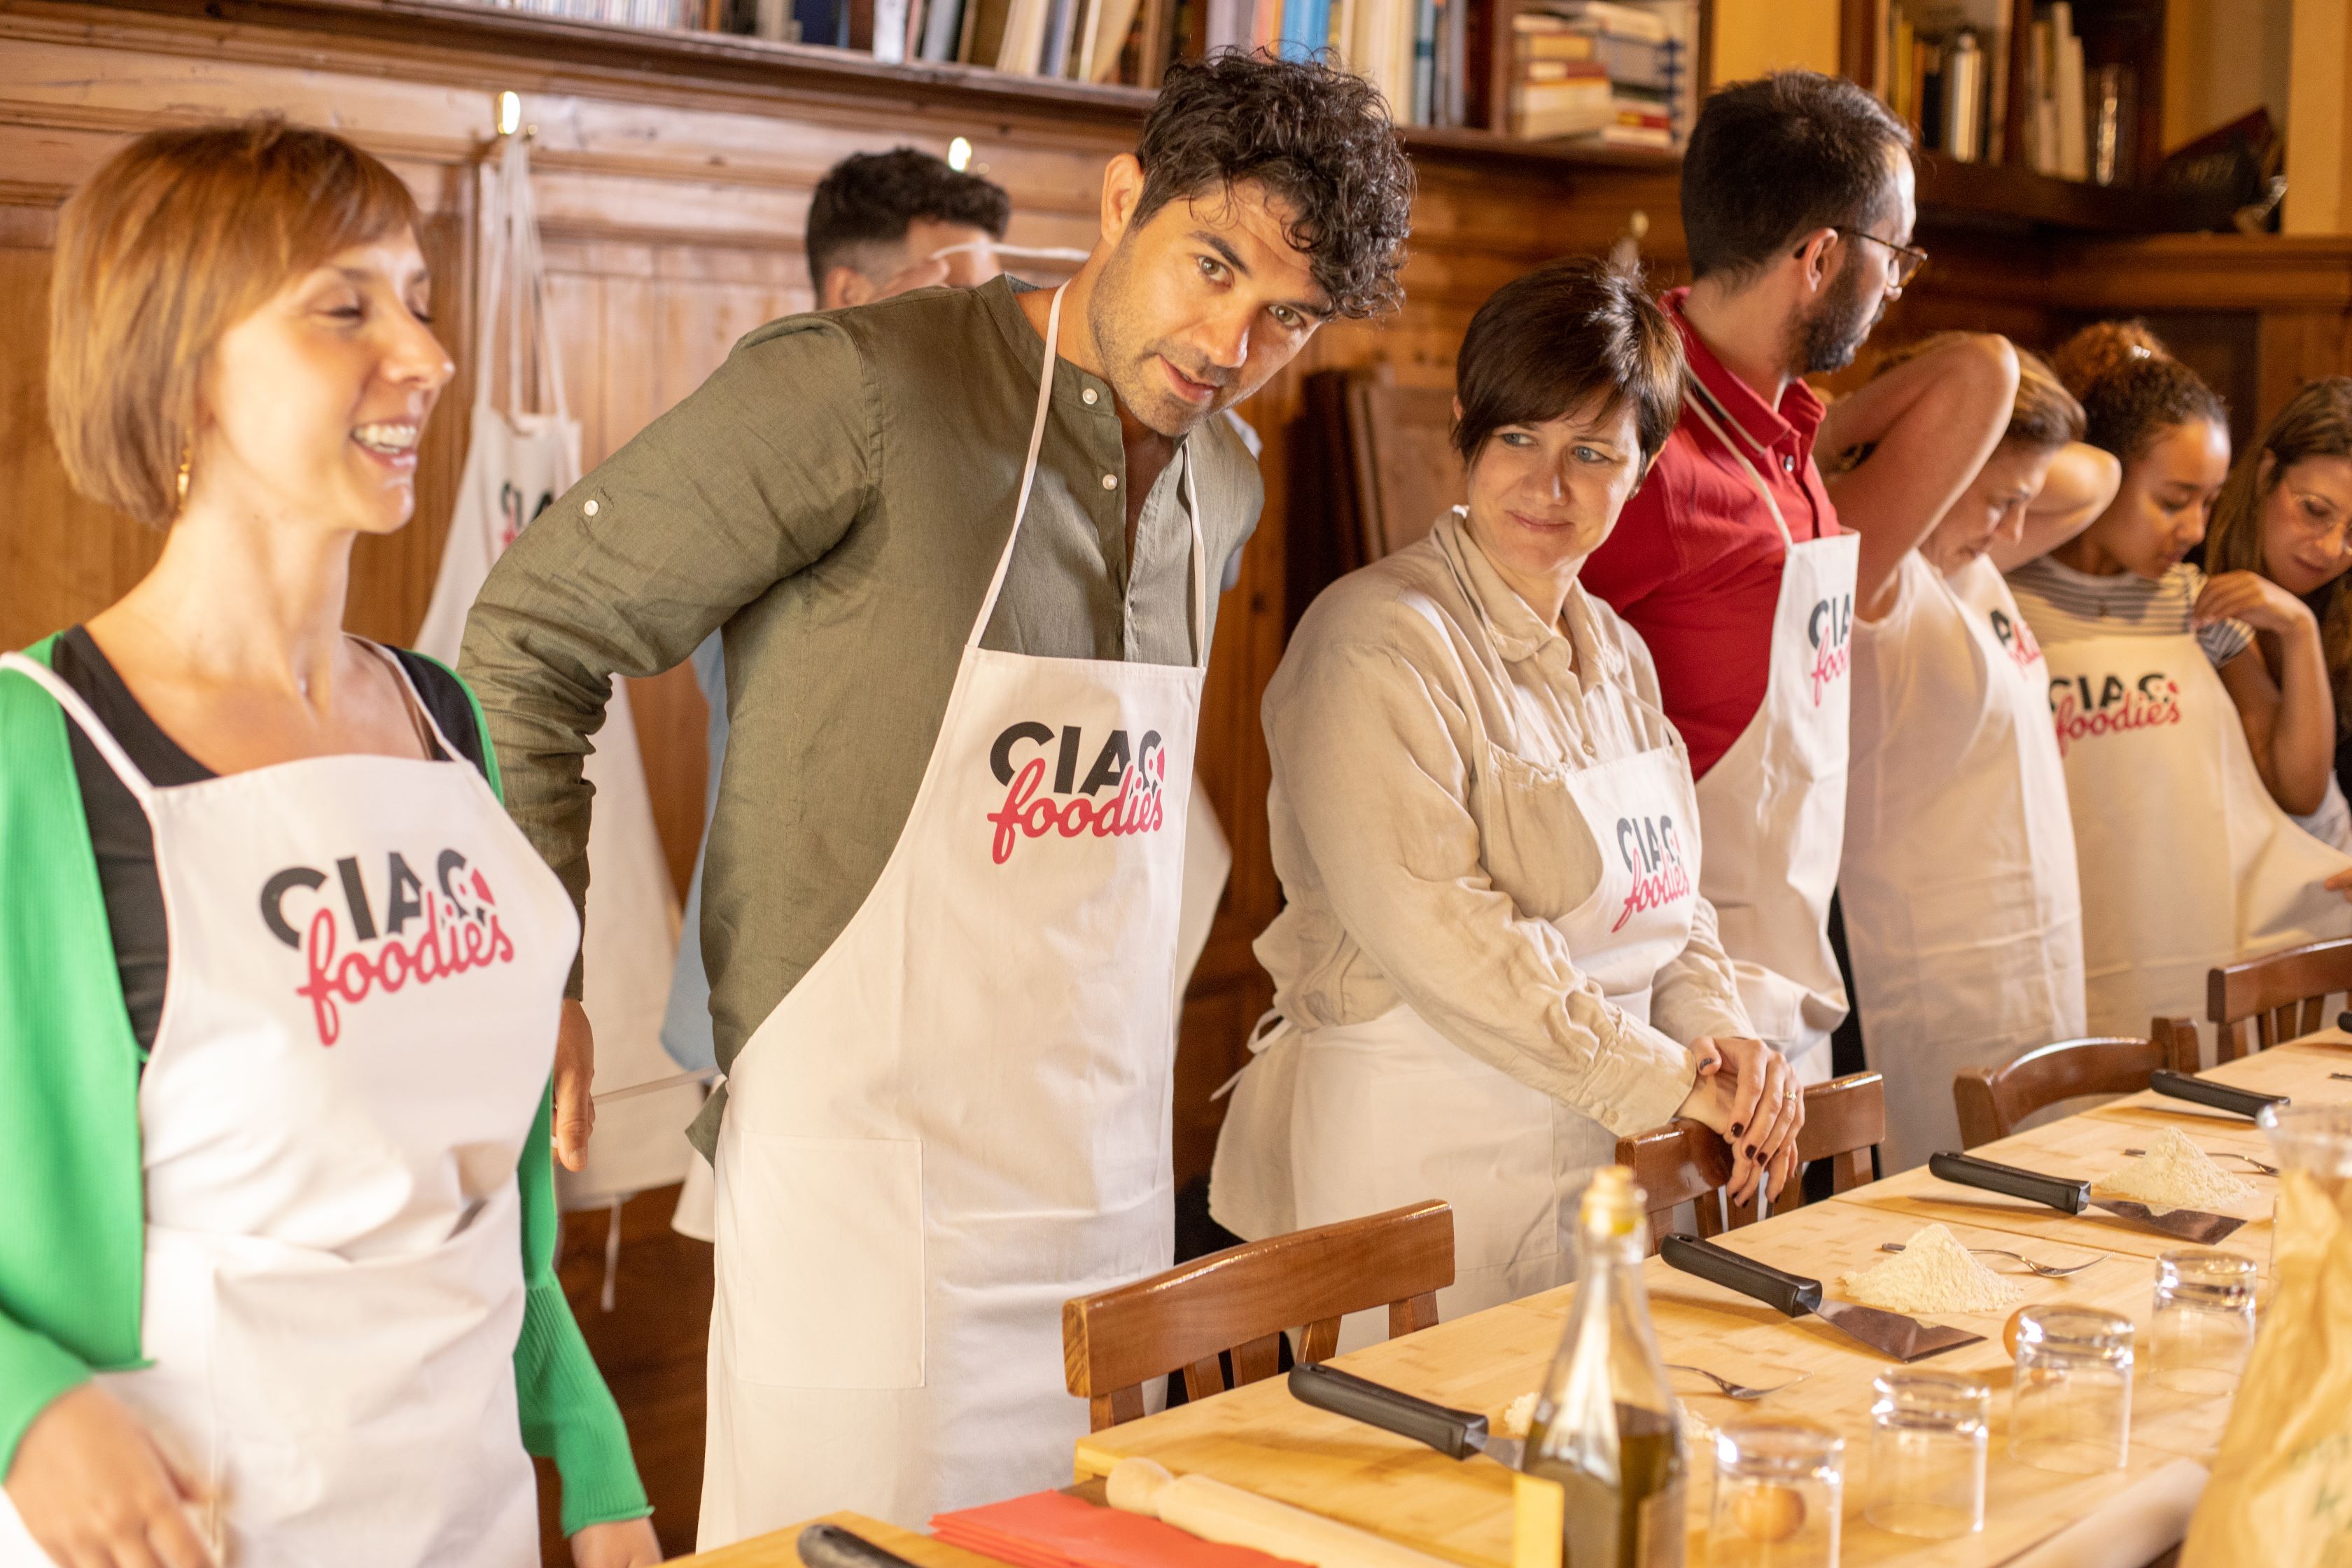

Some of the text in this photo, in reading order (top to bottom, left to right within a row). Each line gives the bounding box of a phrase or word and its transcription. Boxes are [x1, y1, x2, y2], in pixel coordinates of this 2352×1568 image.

[2055, 685, 2181, 757] foodies
[987, 757, 1163, 864] foodies
[1611, 844, 1690, 932] foodies
[295, 890, 514, 1047] foodies
